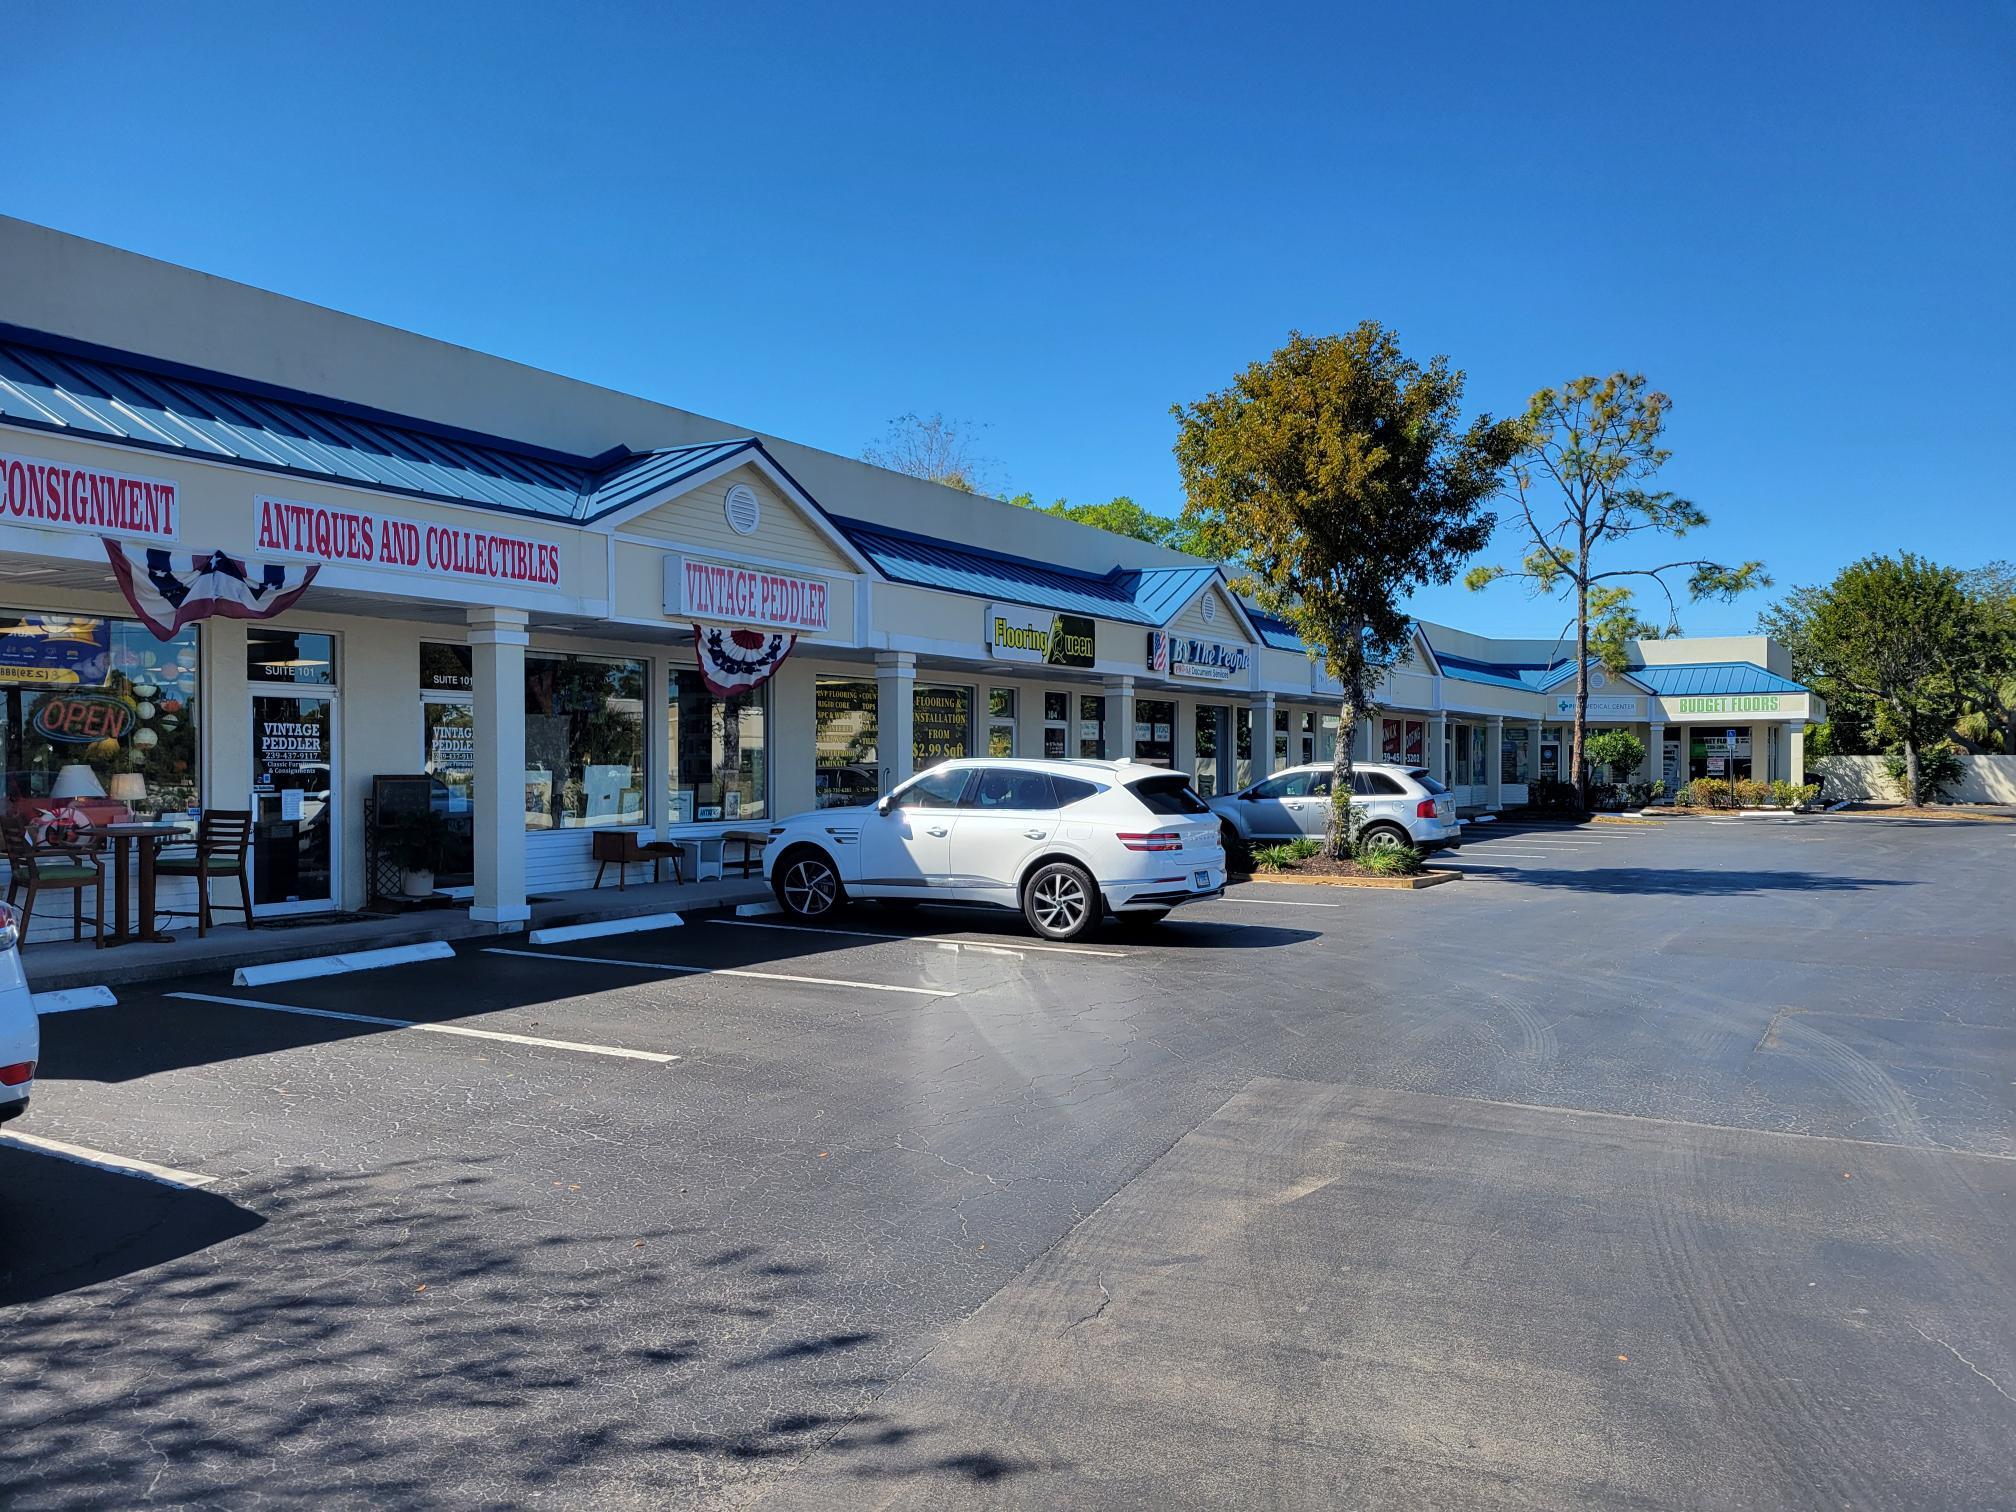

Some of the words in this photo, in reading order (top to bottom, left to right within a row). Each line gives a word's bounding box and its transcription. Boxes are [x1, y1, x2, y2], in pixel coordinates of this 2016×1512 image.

[259, 501, 374, 561] ANTIQUES
[379, 520, 420, 566] AND
[425, 526, 559, 585] COLLECTIBLES
[685, 562, 757, 618] VINTAGE
[761, 575, 827, 628] PEDDLER
[994, 617, 1050, 657] Flooring
[1194, 640, 1216, 666] The
[1217, 644, 1251, 673] People
[265, 665, 295, 676] SUITE
[299, 667, 315, 677] 101
[433, 674, 458, 685] SUITE
[829, 690, 858, 699] FLOORING
[915, 696, 955, 708] FLOORING
[1679, 697, 1726, 713] BUDGET
[1731, 696, 1779, 712] FLOORS
[43, 700, 126, 738] OPEN
[1048, 710, 1058, 719] 104
[263, 722, 320, 737] VINTAGE
[433, 726, 473, 739] VINTAG
[928, 729, 950, 739] FROM
[262, 736, 321, 751] PEDDLER
[432, 740, 473, 751] PEDDLE
[912, 742, 941, 758] $2.99
[265, 752, 318, 760] 239-437-9117
